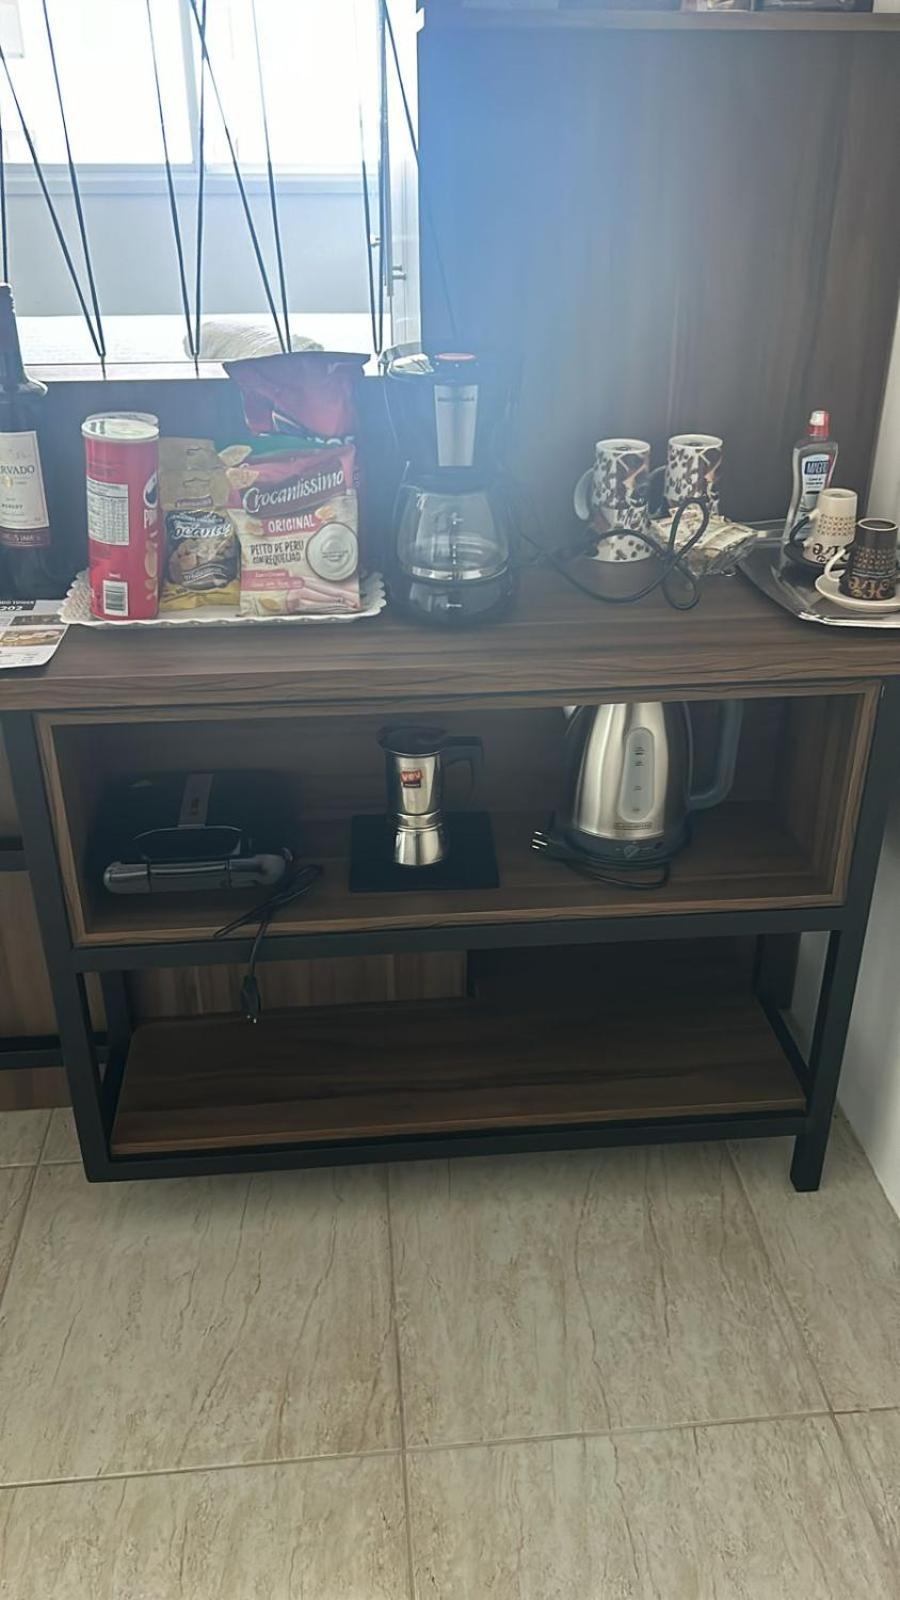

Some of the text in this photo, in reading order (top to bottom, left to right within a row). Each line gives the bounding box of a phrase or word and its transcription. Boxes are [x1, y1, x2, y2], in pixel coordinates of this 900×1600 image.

[242, 470, 344, 514] Crocantissimo
[268, 514, 316, 533] ORIGINAL
[250, 540, 304, 555] PEITO DE PERU
